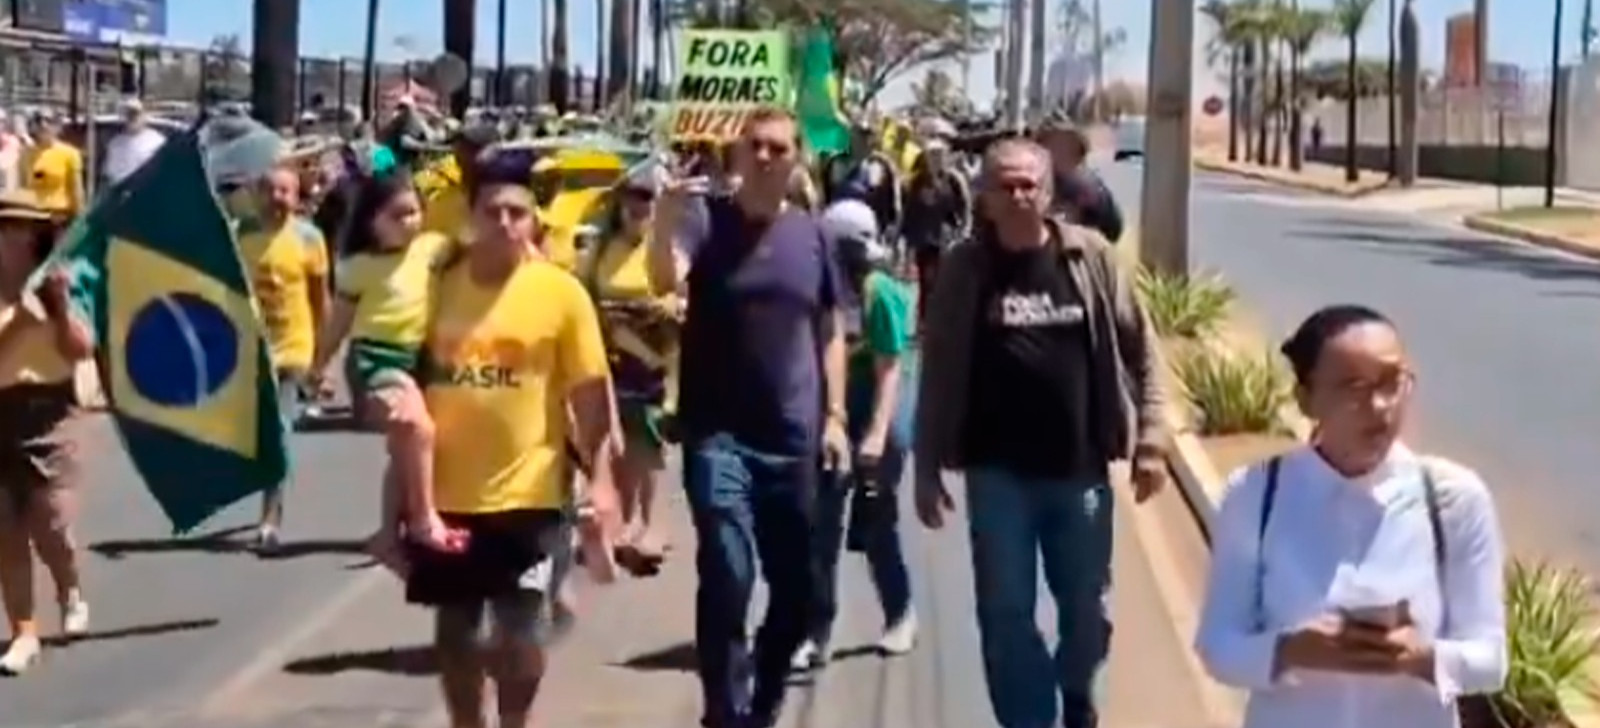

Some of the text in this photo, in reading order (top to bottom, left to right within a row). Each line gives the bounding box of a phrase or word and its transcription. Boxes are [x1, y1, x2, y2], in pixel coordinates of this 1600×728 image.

[687, 37, 770, 67] FORA
[678, 73, 779, 102] MORAES
[674, 107, 747, 136] BUZI
[430, 364, 522, 390] ASIL
